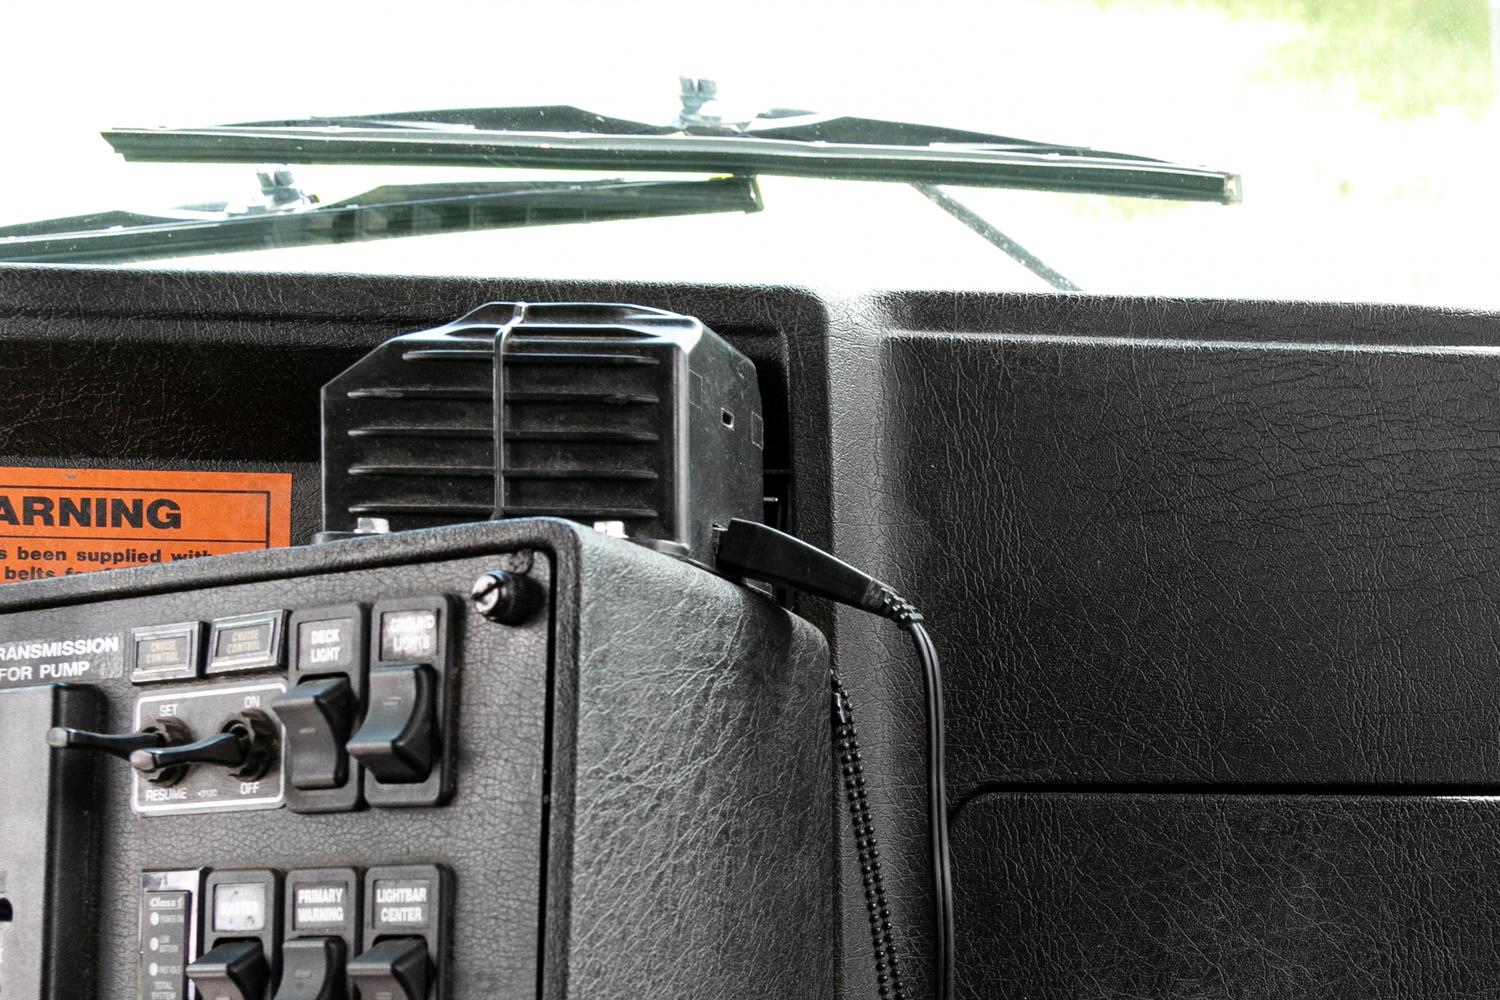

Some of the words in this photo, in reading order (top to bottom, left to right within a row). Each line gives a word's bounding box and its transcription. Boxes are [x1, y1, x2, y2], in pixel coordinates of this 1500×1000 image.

[17, 546, 67, 560] been
[77, 549, 162, 564] supplied
[5, 566, 55, 580] belts
[311, 629, 340, 645] DECK
[310, 647, 340, 663] LIGHT
[0, 665, 33, 681] FOR
[39, 661, 90, 679] PUMP
[244, 696, 260, 708] ON
[159, 704, 178, 717] SET
[145, 787, 187, 801] RESUME
[240, 782, 260, 795] OFF
[298, 888, 344, 904] PRIMARY
[376, 887, 428, 903] LIGHTBAR
[297, 906, 344, 922] WARNING
[381, 907, 422, 922] CENTER
